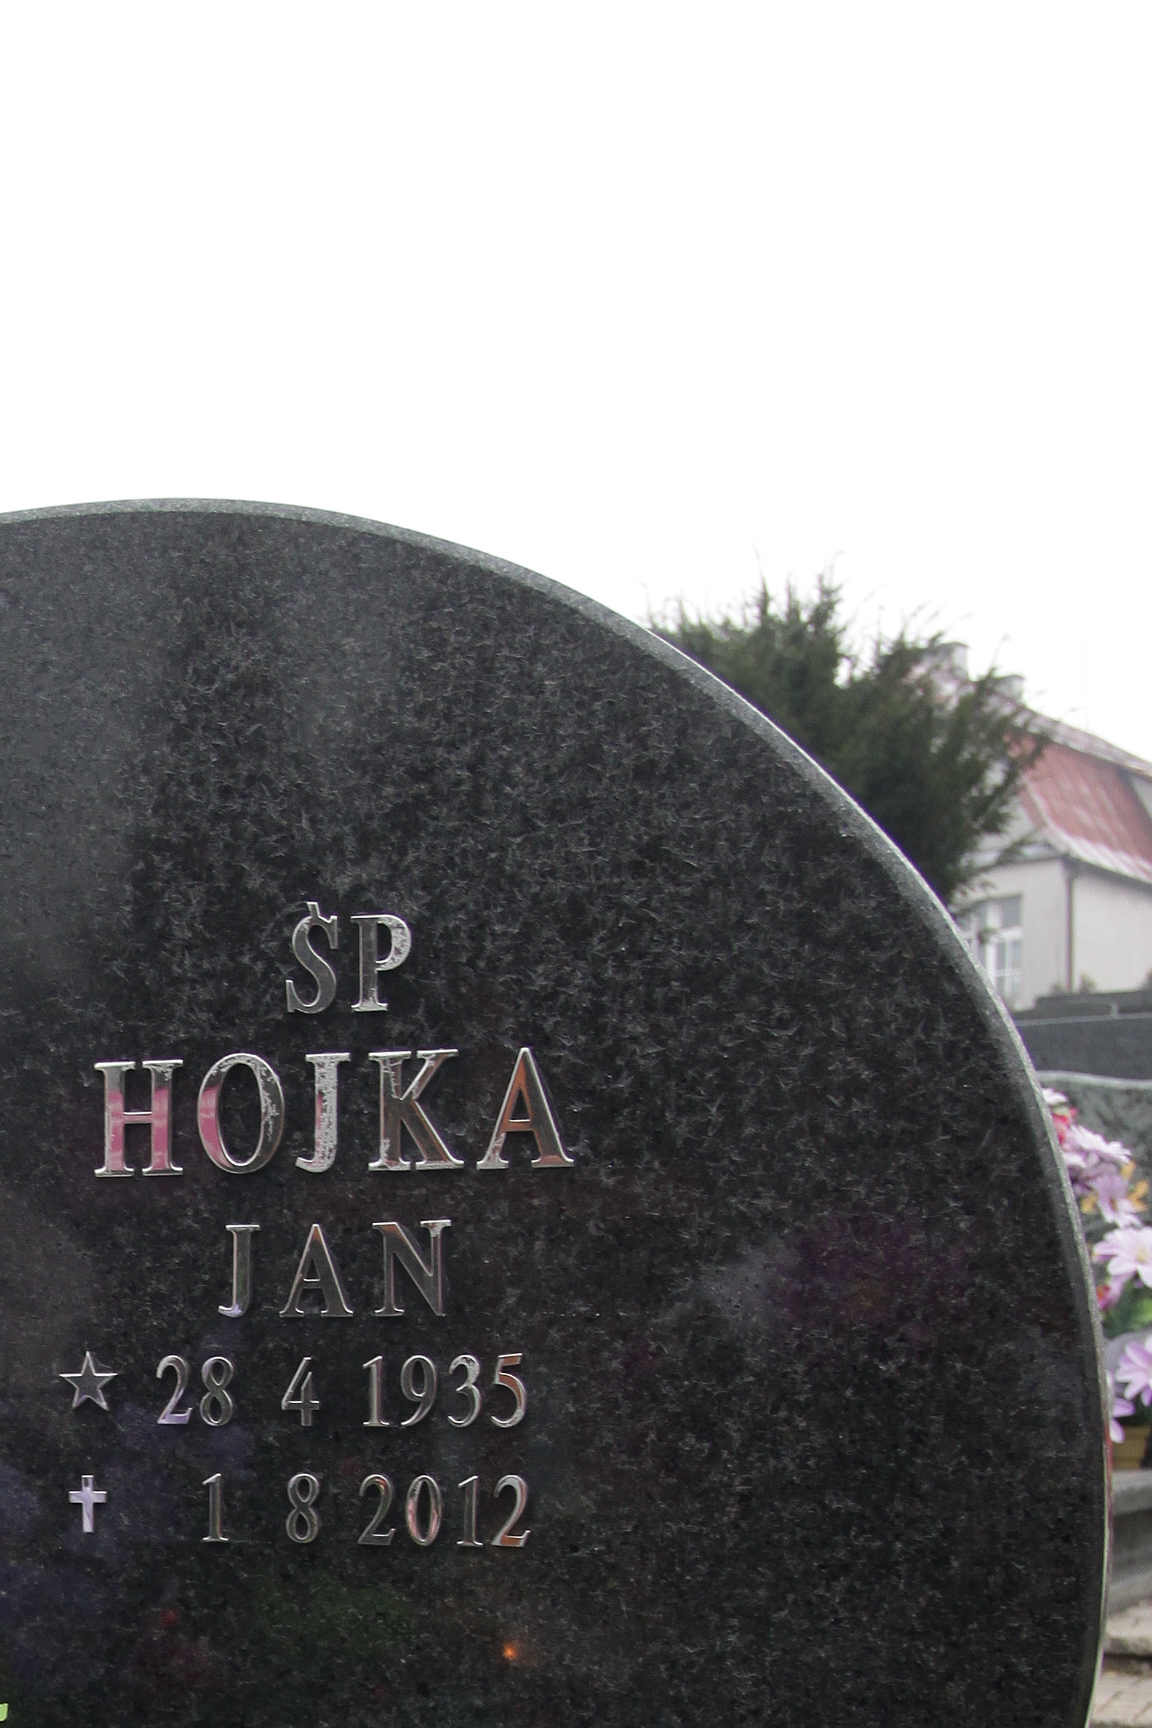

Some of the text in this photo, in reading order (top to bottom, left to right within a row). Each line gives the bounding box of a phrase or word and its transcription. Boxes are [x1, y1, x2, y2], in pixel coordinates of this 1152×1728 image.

[94, 1047, 574, 1177] HOJKA
[218, 1219, 451, 1318] JAN
[156, 1352, 527, 1428] 28 4 1935
[201, 1473, 531, 1548] 1 8 2012
